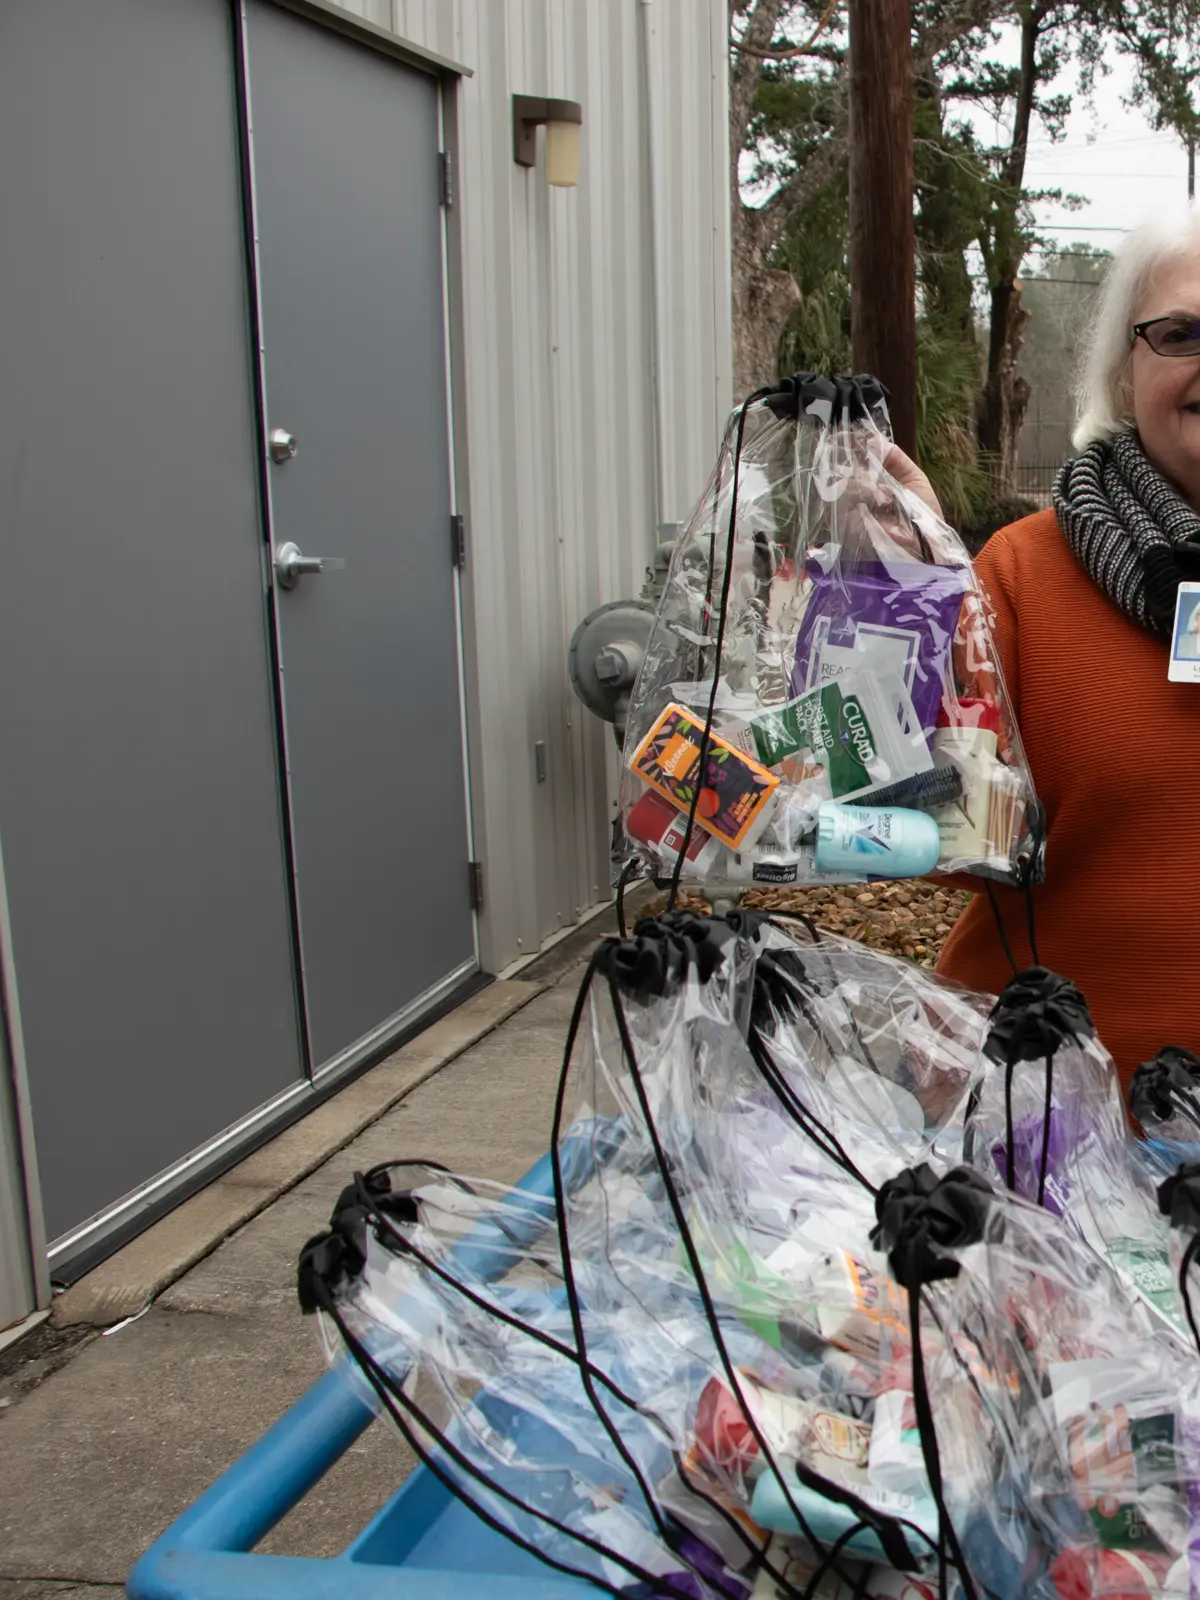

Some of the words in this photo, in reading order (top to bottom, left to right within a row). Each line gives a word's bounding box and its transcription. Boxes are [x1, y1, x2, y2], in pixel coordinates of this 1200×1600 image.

[822, 663, 853, 676] REA
[795, 703, 808, 734] PACK
[842, 702, 876, 763] CURAD
[820, 728, 835, 749] AID
[662, 735, 695, 777] Kleenex
[883, 812, 893, 839] Degree
